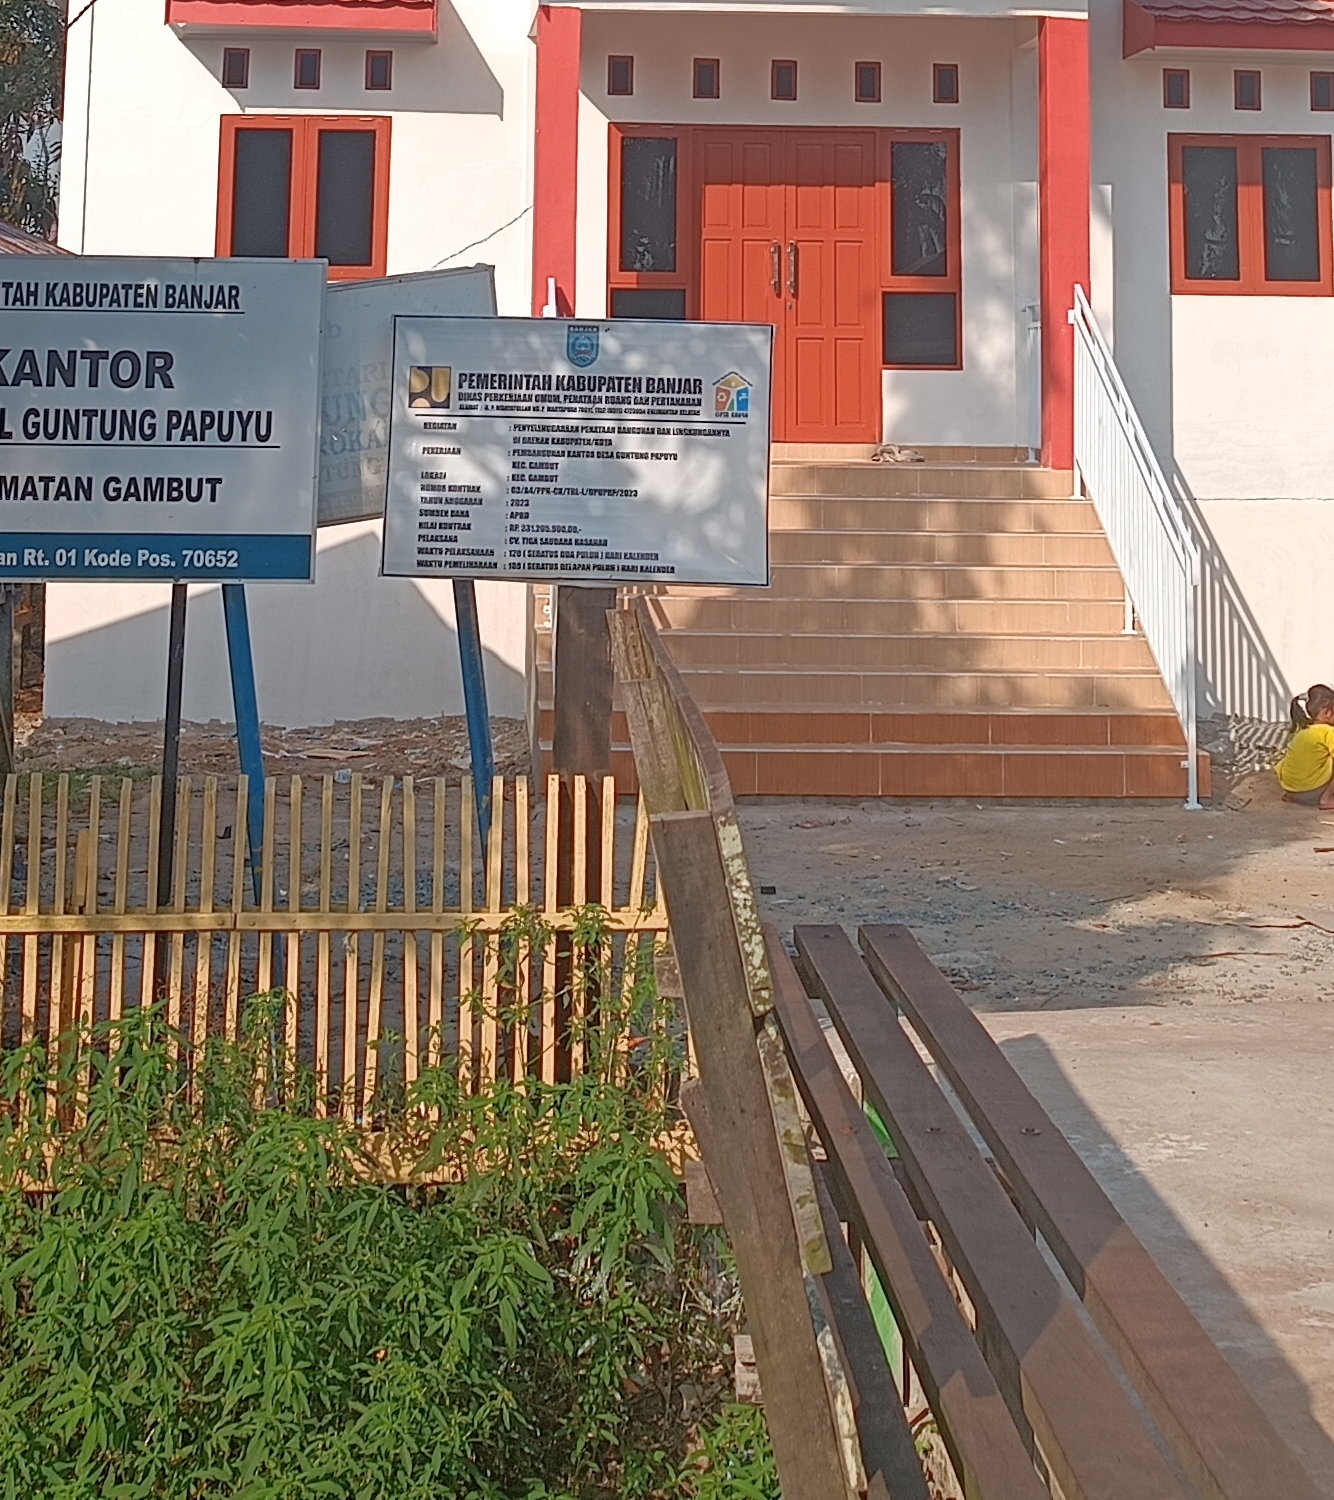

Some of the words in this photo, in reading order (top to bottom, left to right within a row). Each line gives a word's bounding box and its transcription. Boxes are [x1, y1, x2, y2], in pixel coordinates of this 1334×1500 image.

[45, 282, 158, 309] KABUPATEN
[166, 284, 240, 310] BANJAR
[458, 373, 552, 391] PEMERINTAH
[556, 374, 642, 393] KABUPATEN
[646, 376, 703, 395] BANJAR
[458, 392, 482, 401] DINAS
[564, 395, 603, 405] PENATAAN
[605, 396, 632, 405] RUANG
[634, 396, 649, 406] DAN
[22, 408, 155, 442] GUNTUNG
[166, 410, 273, 443] PAPUYU
[103, 476, 223, 503] GAMBUT
[510, 499, 530, 507] 2023
[23, 548, 50, 567] Rt.
[55, 549, 77, 567] 01
[84, 549, 131, 567] Kode
[137, 550, 176, 568] Pos.
[182, 550, 239, 568] 70652
